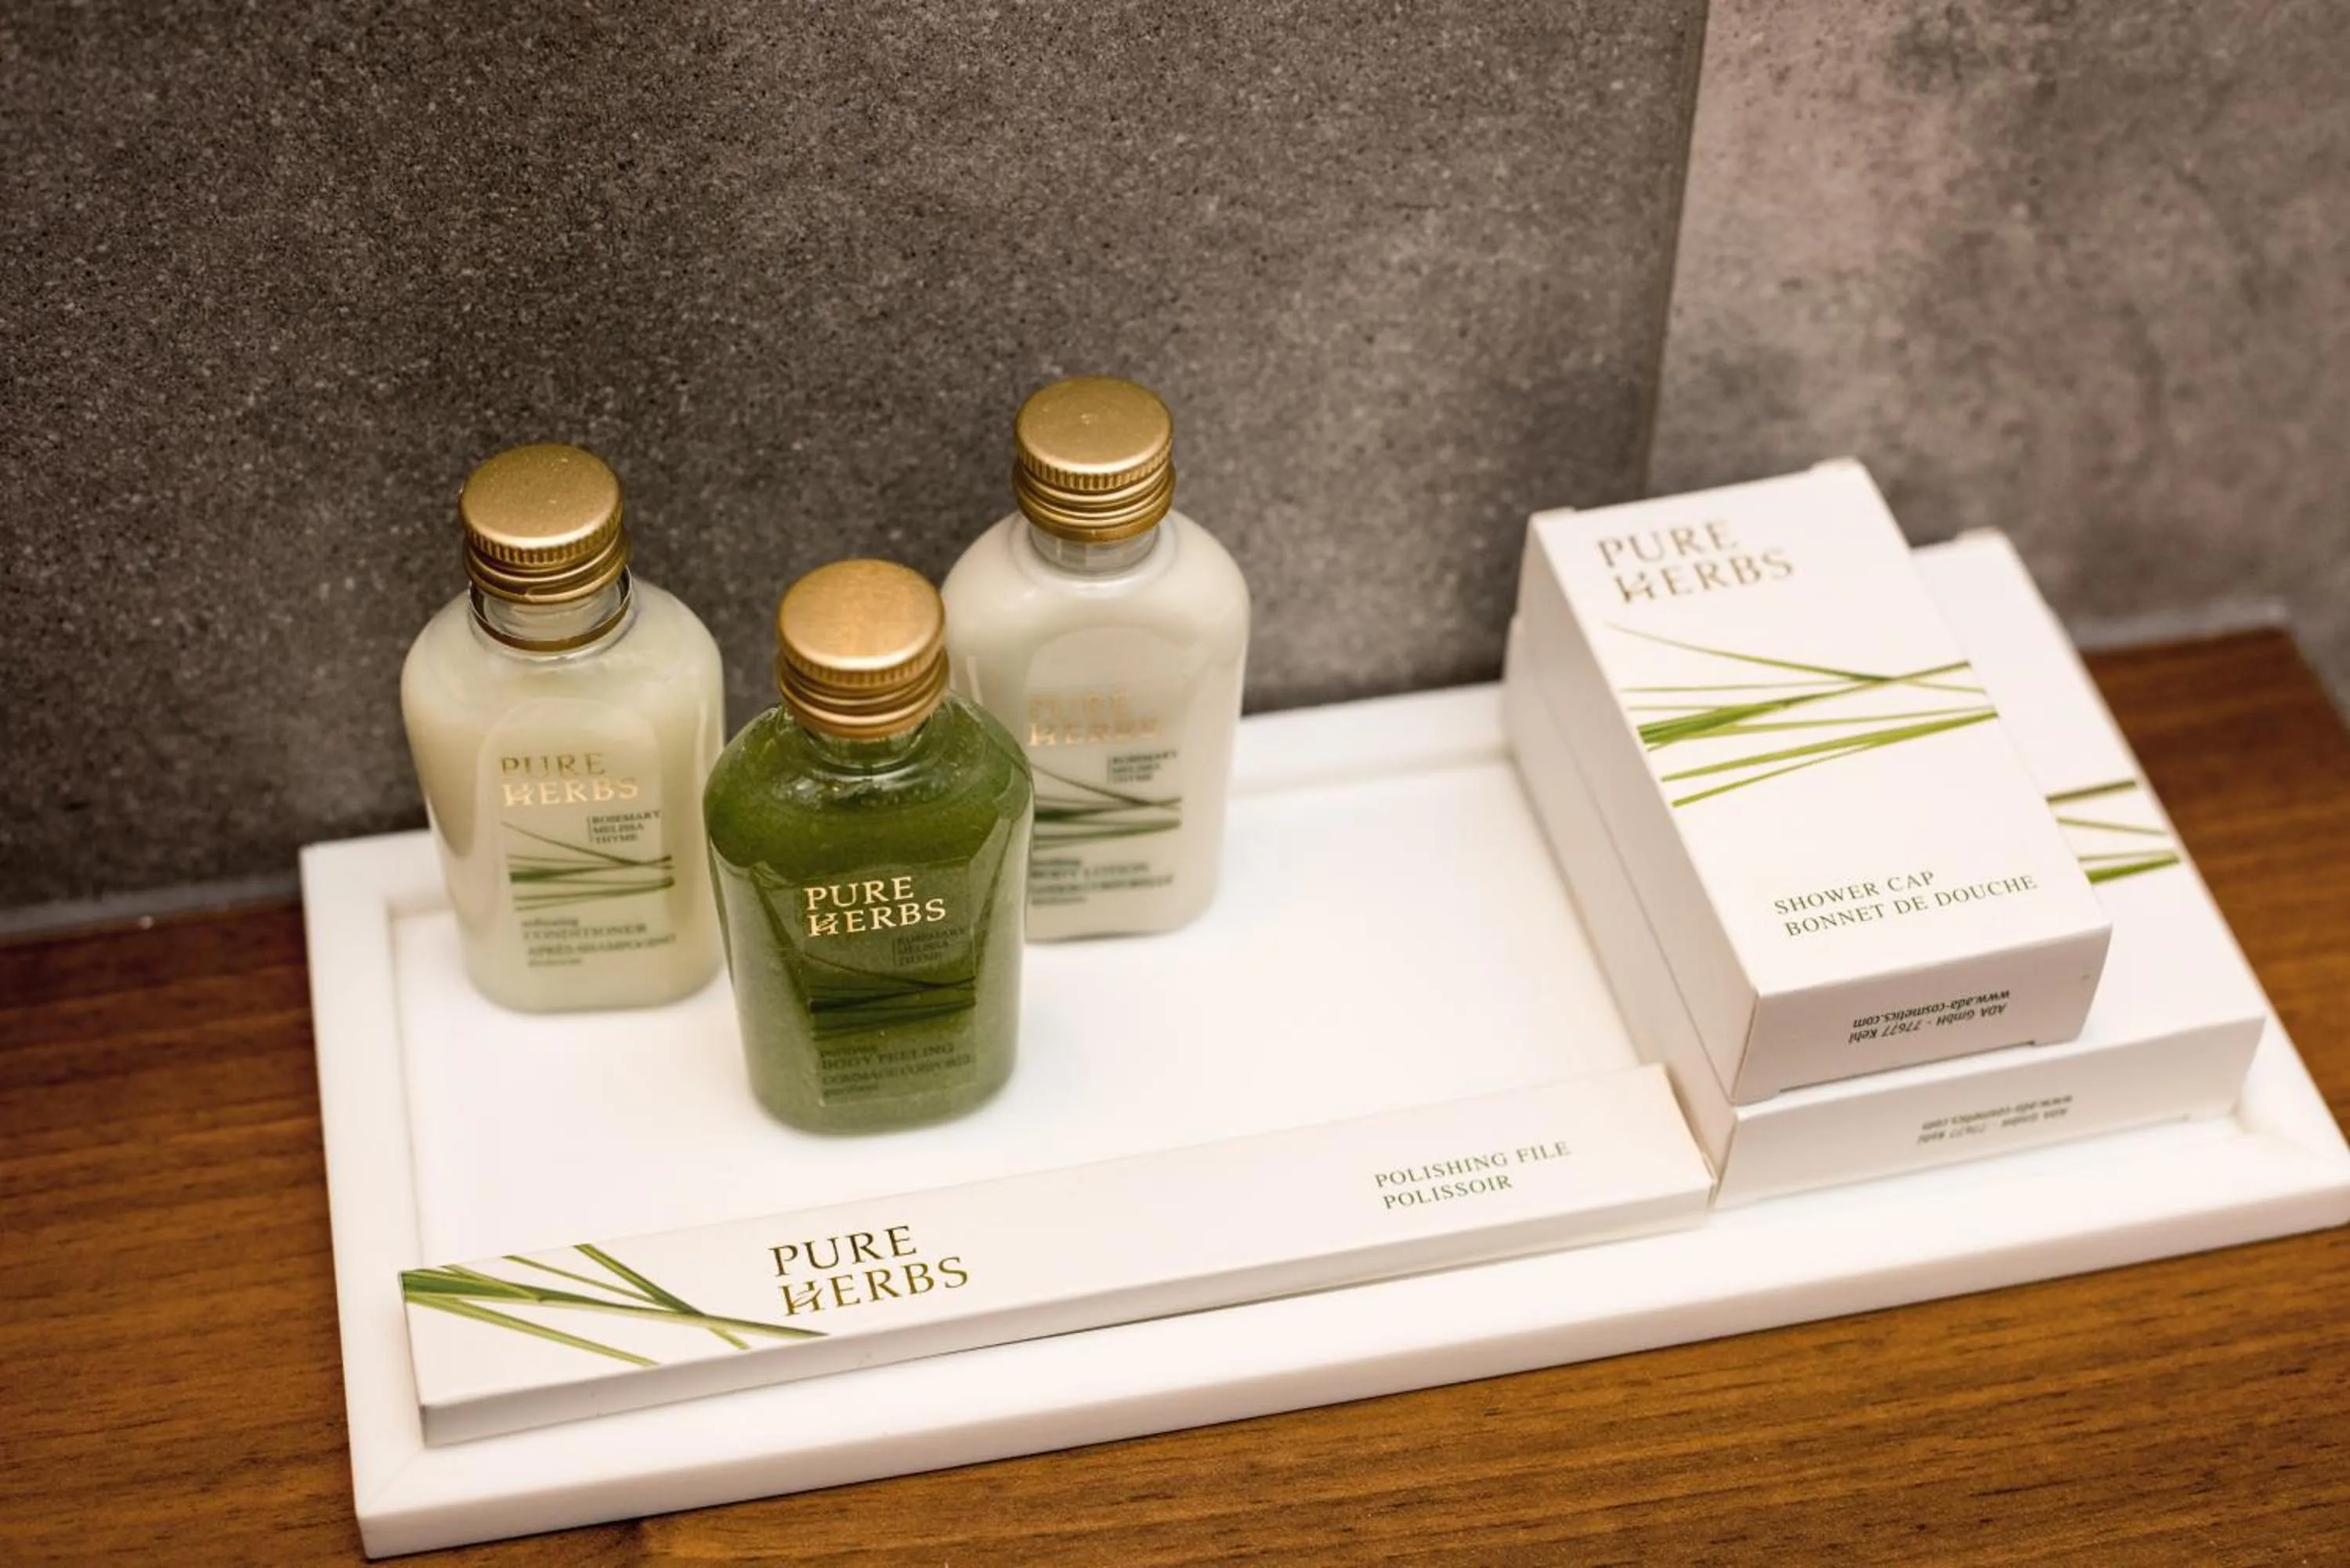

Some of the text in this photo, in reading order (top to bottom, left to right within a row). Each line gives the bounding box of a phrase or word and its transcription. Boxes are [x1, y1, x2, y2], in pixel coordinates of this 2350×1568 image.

[1597, 520, 1738, 568] PURE
[1614, 548, 1794, 603] HERBS
[501, 753, 606, 777] PURE
[501, 777, 639, 807] HERBS
[804, 876, 914, 910] PURE
[1774, 870, 1935, 915] SHOWER CAP
[1784, 875, 2039, 938] BONNET DE DOUCHE
[807, 898, 946, 937] HERBS
[1848, 1003, 2008, 1044] ADA GmbH 77677 Kehl
[1853, 990, 2010, 1028] www.ada-cosmetics.com
[1374, 1140, 1572, 1188] POLISHING FILE
[1383, 1174, 1513, 1209] POLISSOIR
[768, 1225, 917, 1277] PURE
[778, 1255, 968, 1317] HERBS
